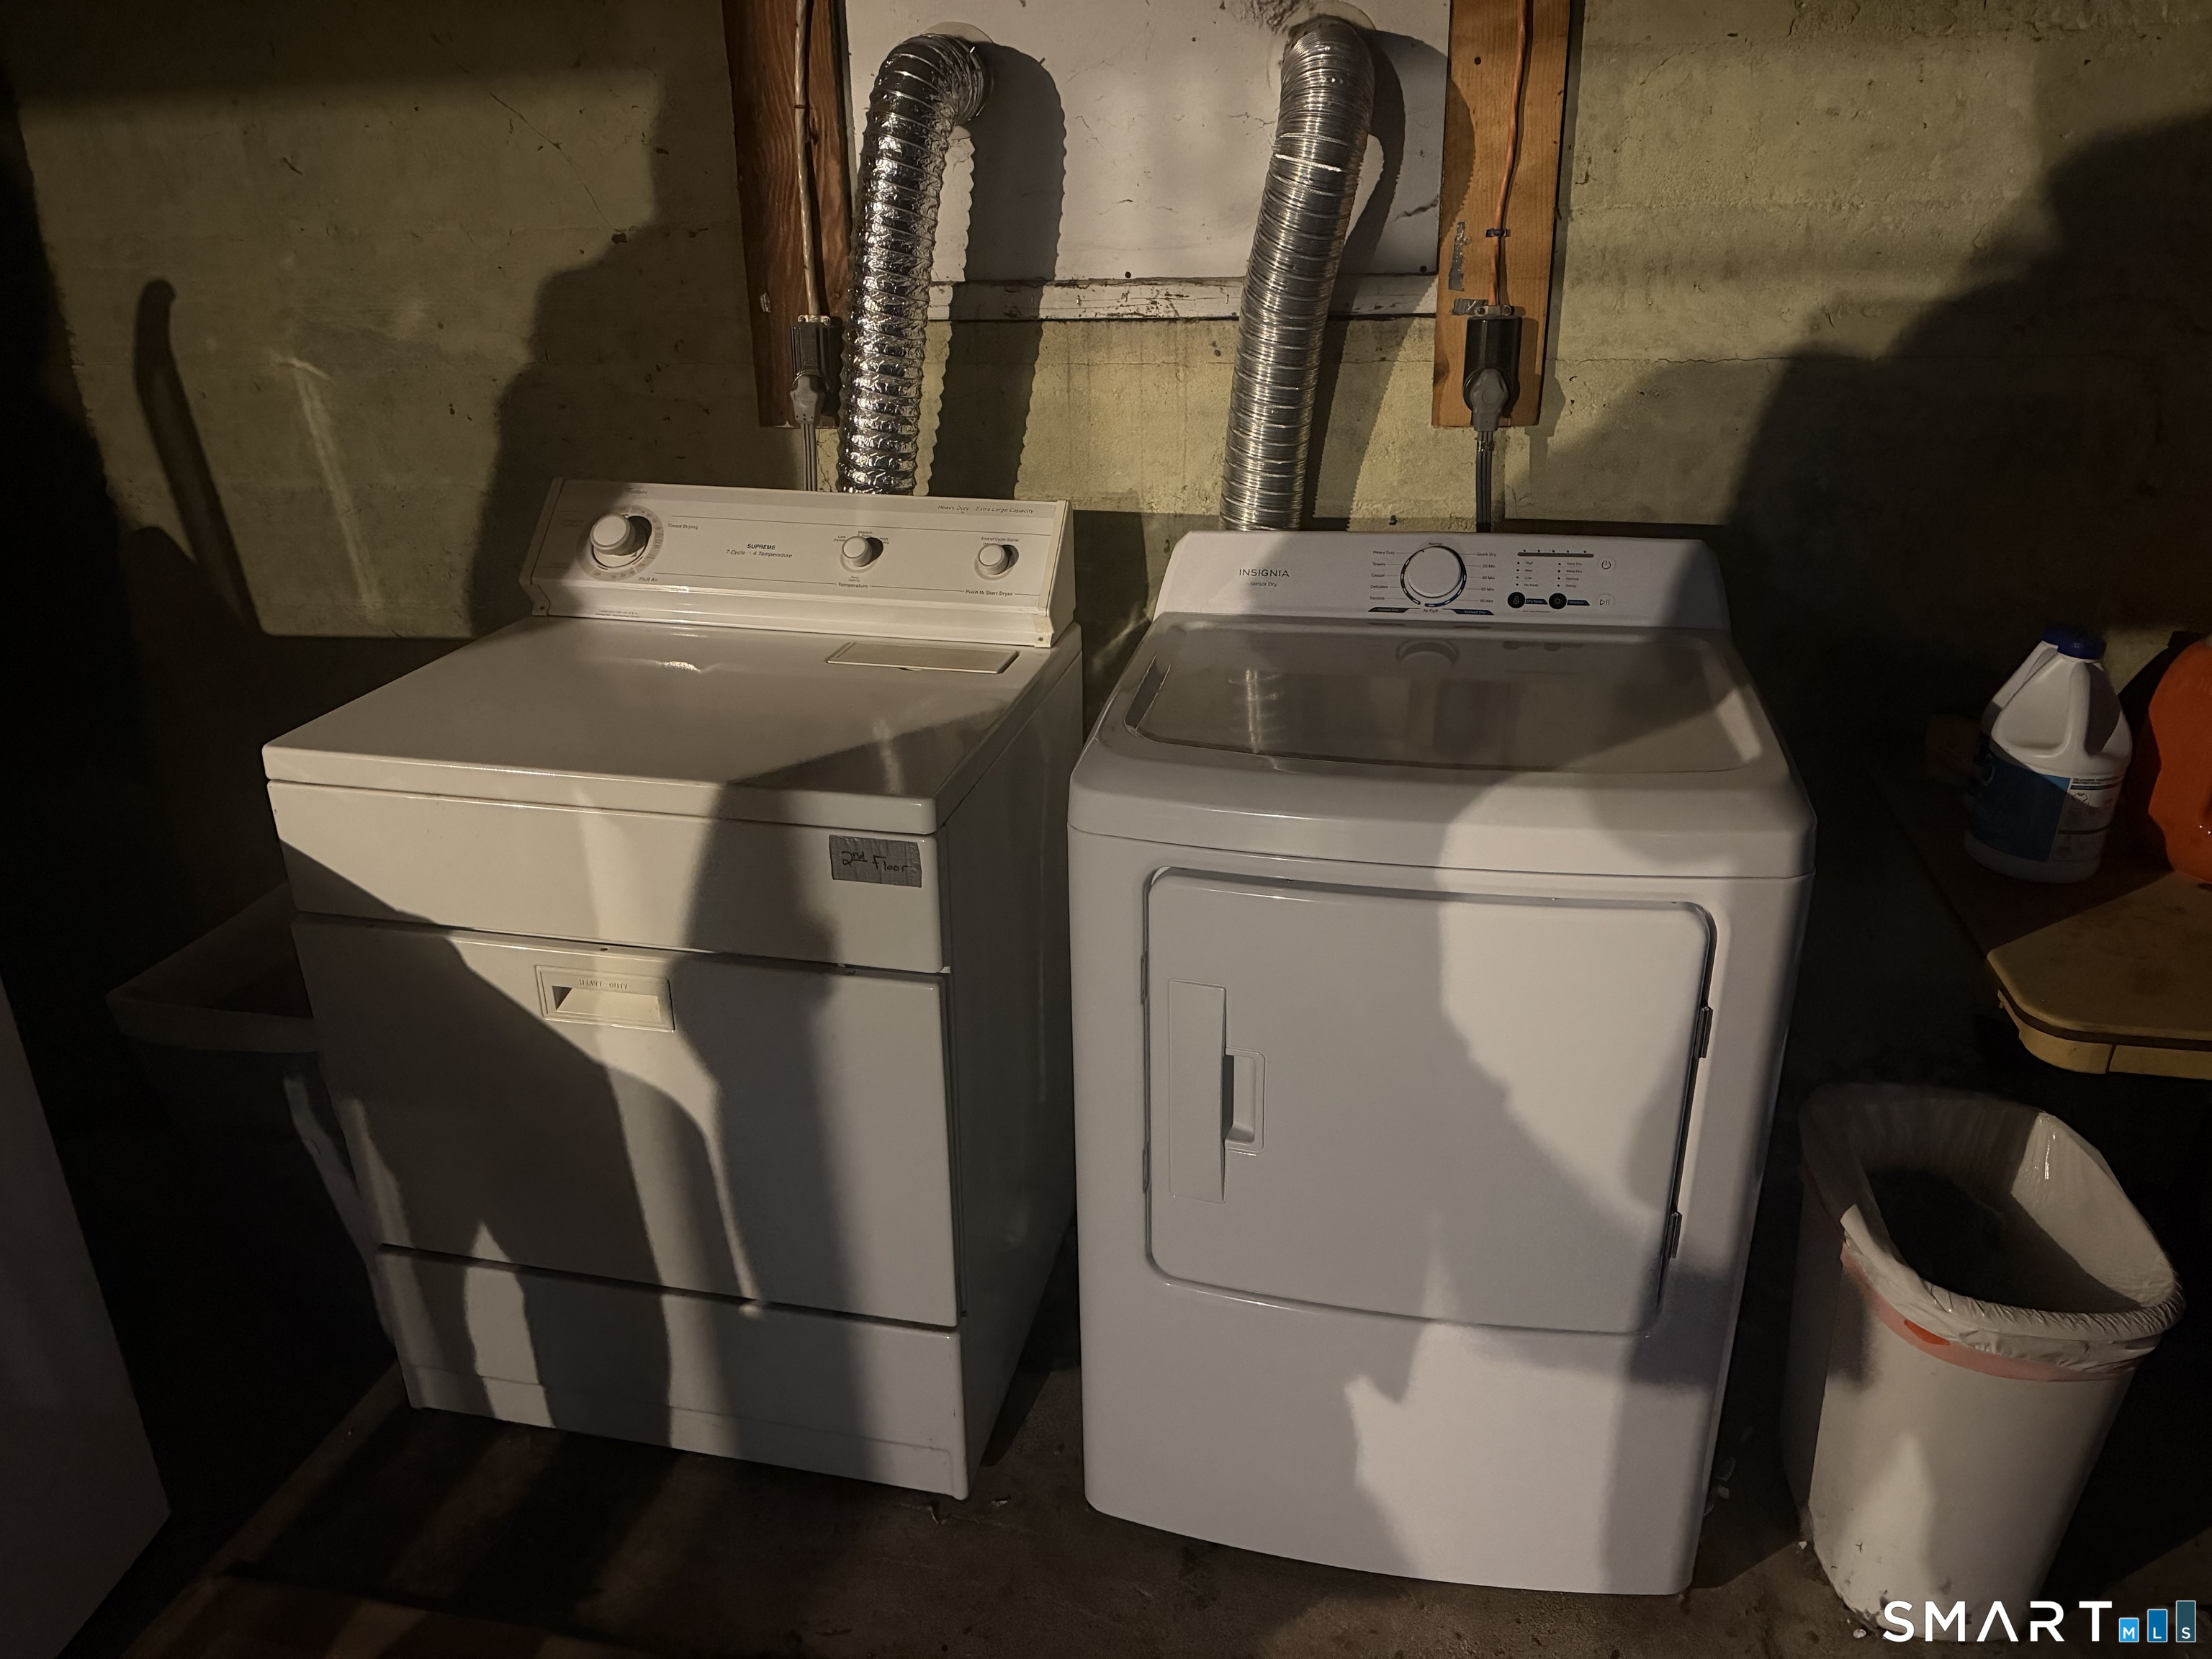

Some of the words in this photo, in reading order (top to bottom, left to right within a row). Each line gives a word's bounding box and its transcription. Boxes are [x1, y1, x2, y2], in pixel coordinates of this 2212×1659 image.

[1239, 569, 1290, 577] INSIGNIA
[841, 850, 868, 868] 2nd
[872, 854, 909, 872] Floor
